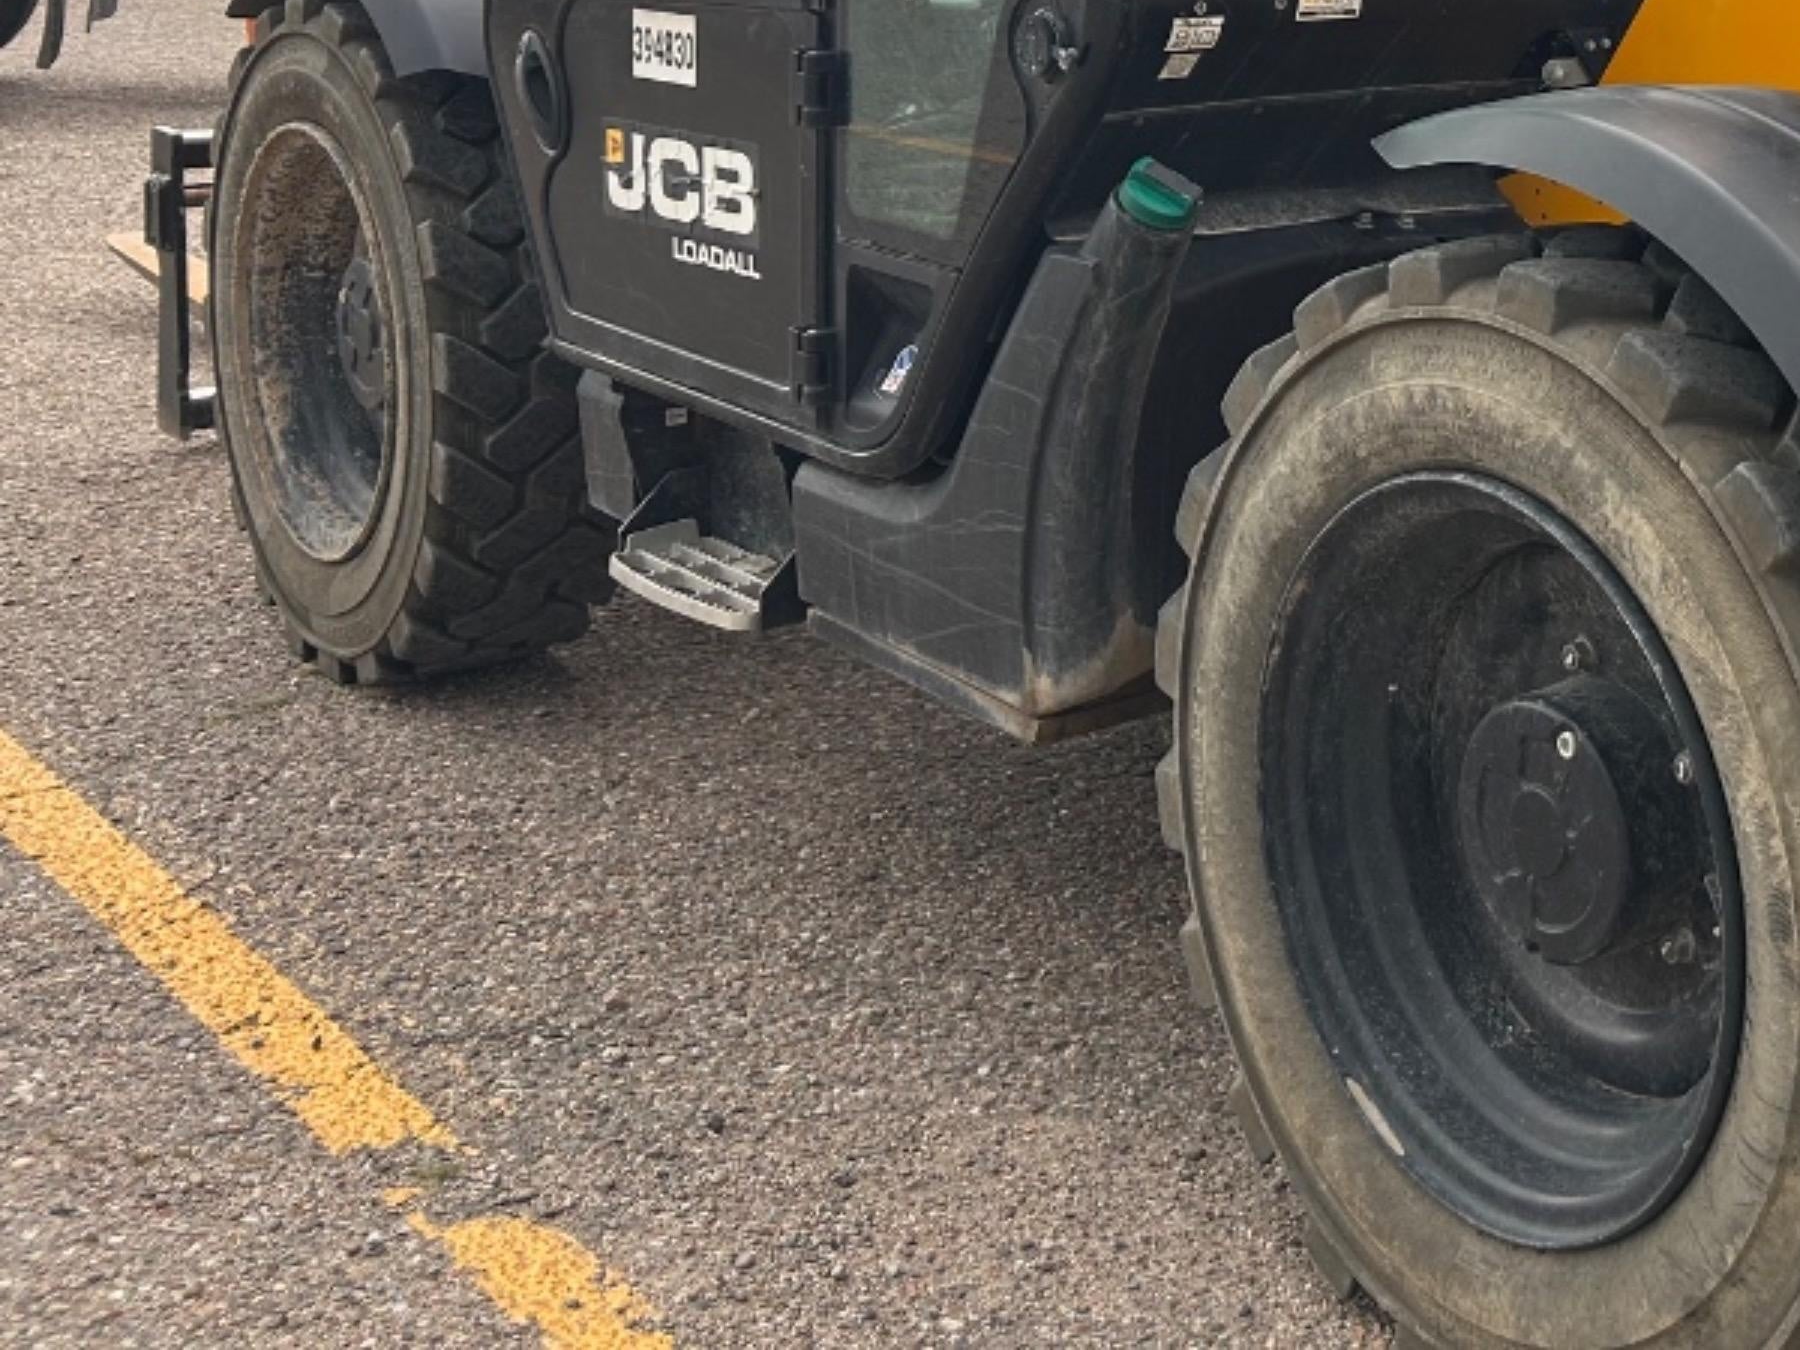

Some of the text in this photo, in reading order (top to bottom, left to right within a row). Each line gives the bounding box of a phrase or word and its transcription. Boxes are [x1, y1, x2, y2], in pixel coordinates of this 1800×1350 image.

[632, 25, 694, 70] 394830
[606, 131, 756, 235] JCB
[671, 236, 763, 280] LOADALL
